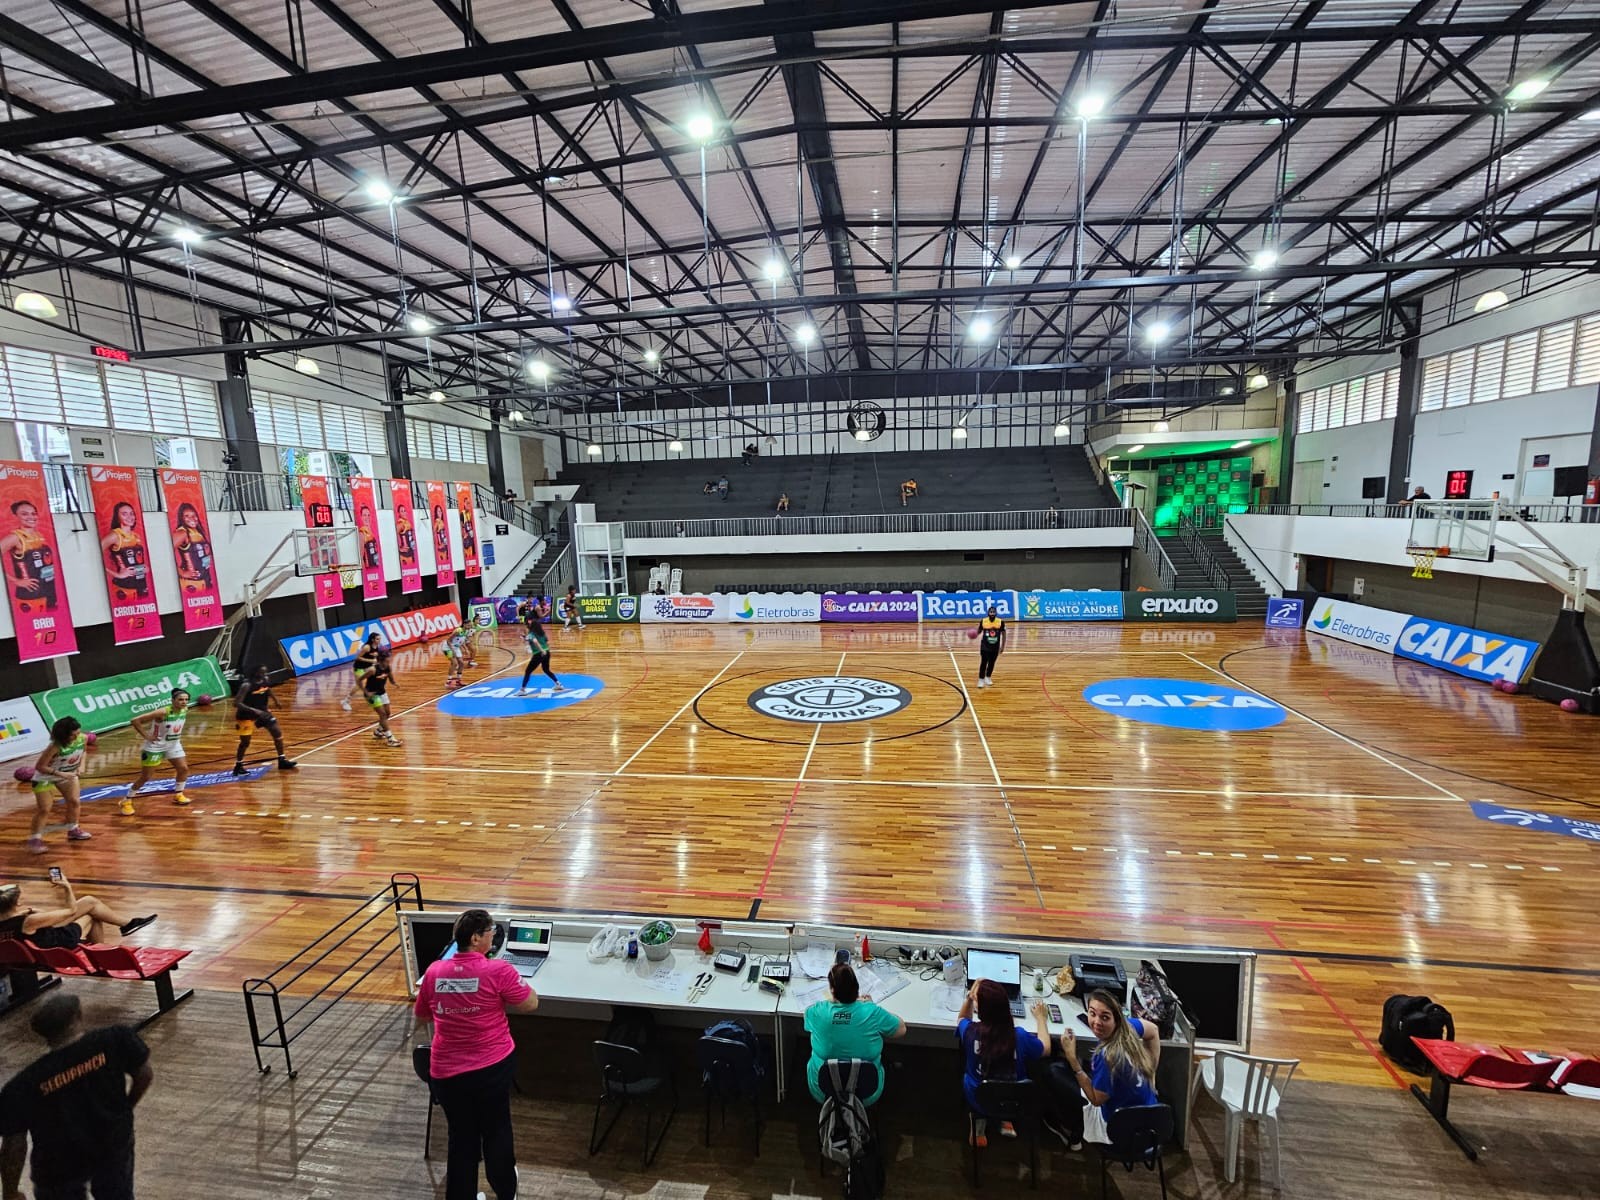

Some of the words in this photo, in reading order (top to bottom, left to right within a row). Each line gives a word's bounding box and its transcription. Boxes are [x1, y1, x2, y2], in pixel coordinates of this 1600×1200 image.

[7, 467, 38, 478] Projeto
[106, 469, 132, 480] Projeto
[581, 598, 612, 606] BASQUETE
[848, 601, 889, 612] CAIXA
[889, 601, 917, 611] 2024
[926, 596, 1011, 616] Renata
[1141, 596, 1219, 614] enxuto
[674, 608, 709, 618] singular
[757, 606, 815, 618] Eletrobras
[1045, 606, 1080, 614] SANTO
[33, 617, 55, 630] BABI
[127, 617, 146, 632] 13
[382, 612, 461, 643] Wilson
[34, 631, 57, 647] 10
[1331, 618, 1392, 645] Eletrobras
[290, 622, 391, 669] CAIXA
[1400, 623, 1527, 682] CAIXA
[833, 678, 895, 694] CLUBE
[72, 676, 174, 713] Unimed
[1091, 694, 1278, 709] CAIXA
[769, 704, 884, 719] CAMPINAS
